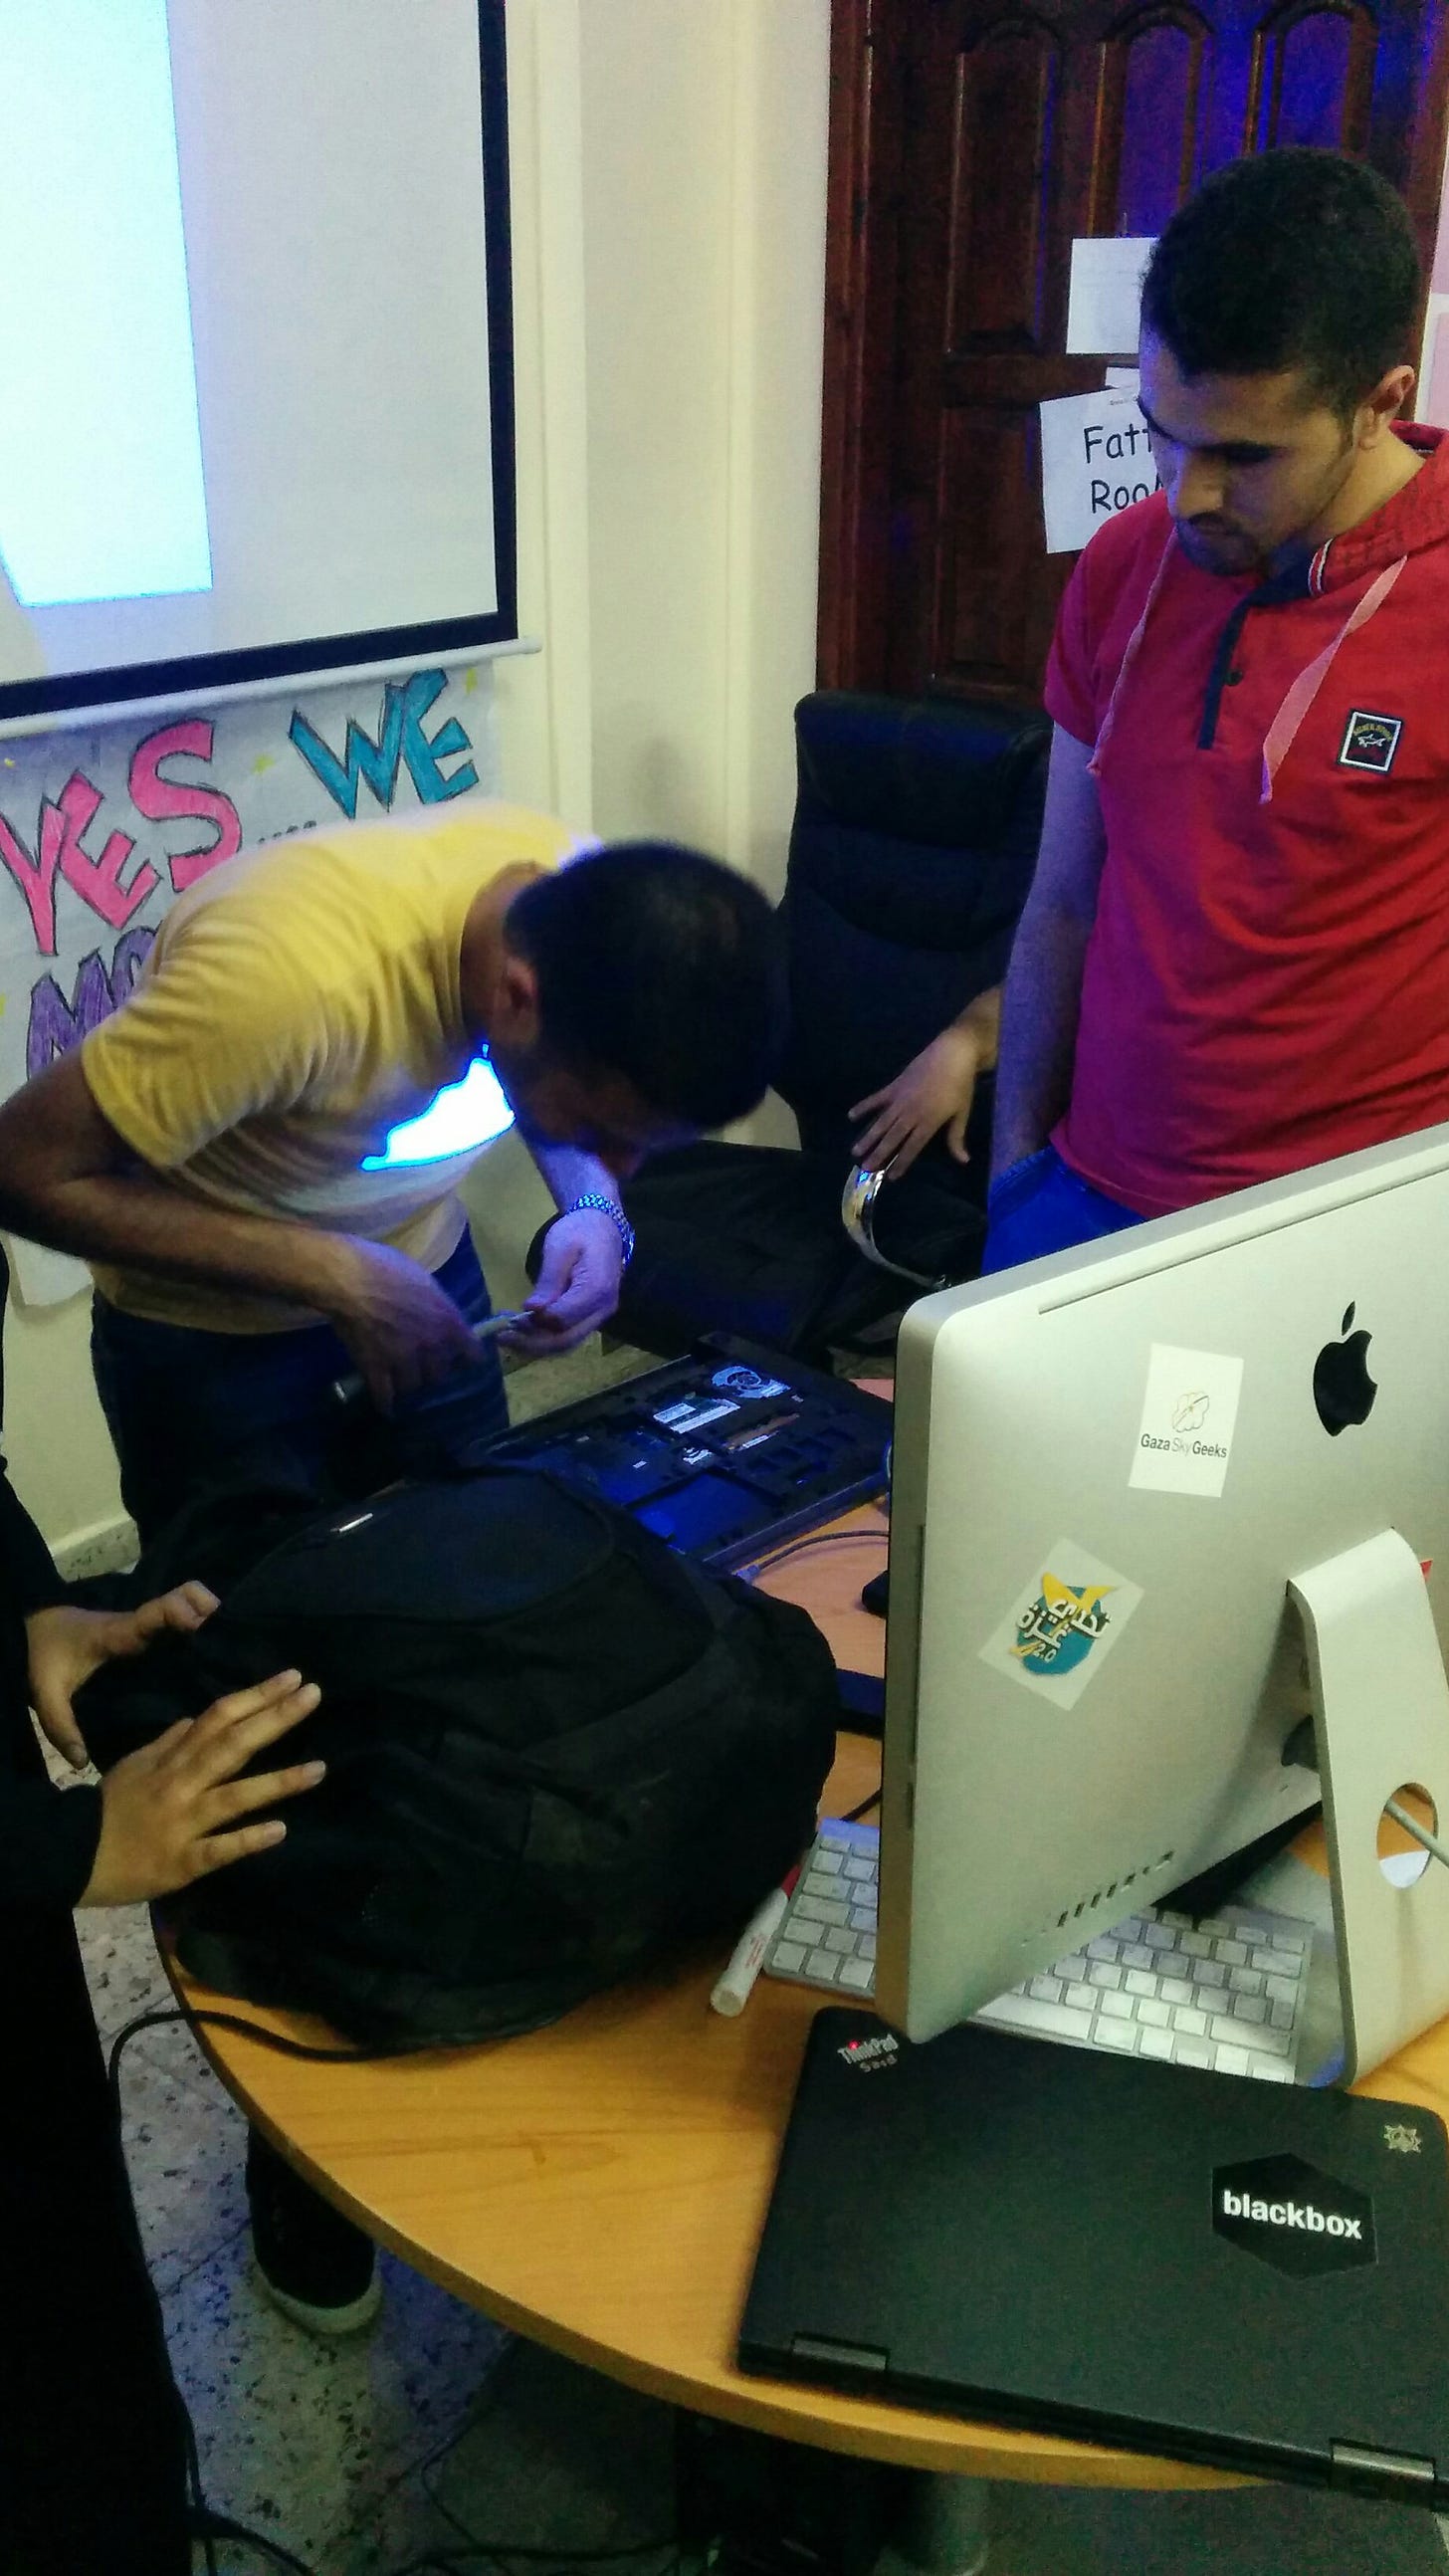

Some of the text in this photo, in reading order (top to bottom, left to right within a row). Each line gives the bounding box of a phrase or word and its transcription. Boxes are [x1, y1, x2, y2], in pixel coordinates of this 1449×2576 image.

[0, 719, 242, 957] YES
[288, 668, 479, 819] WE
[1033, 1643, 1058, 1663] 2.0
[1223, 2188, 1363, 2240] blackbox
